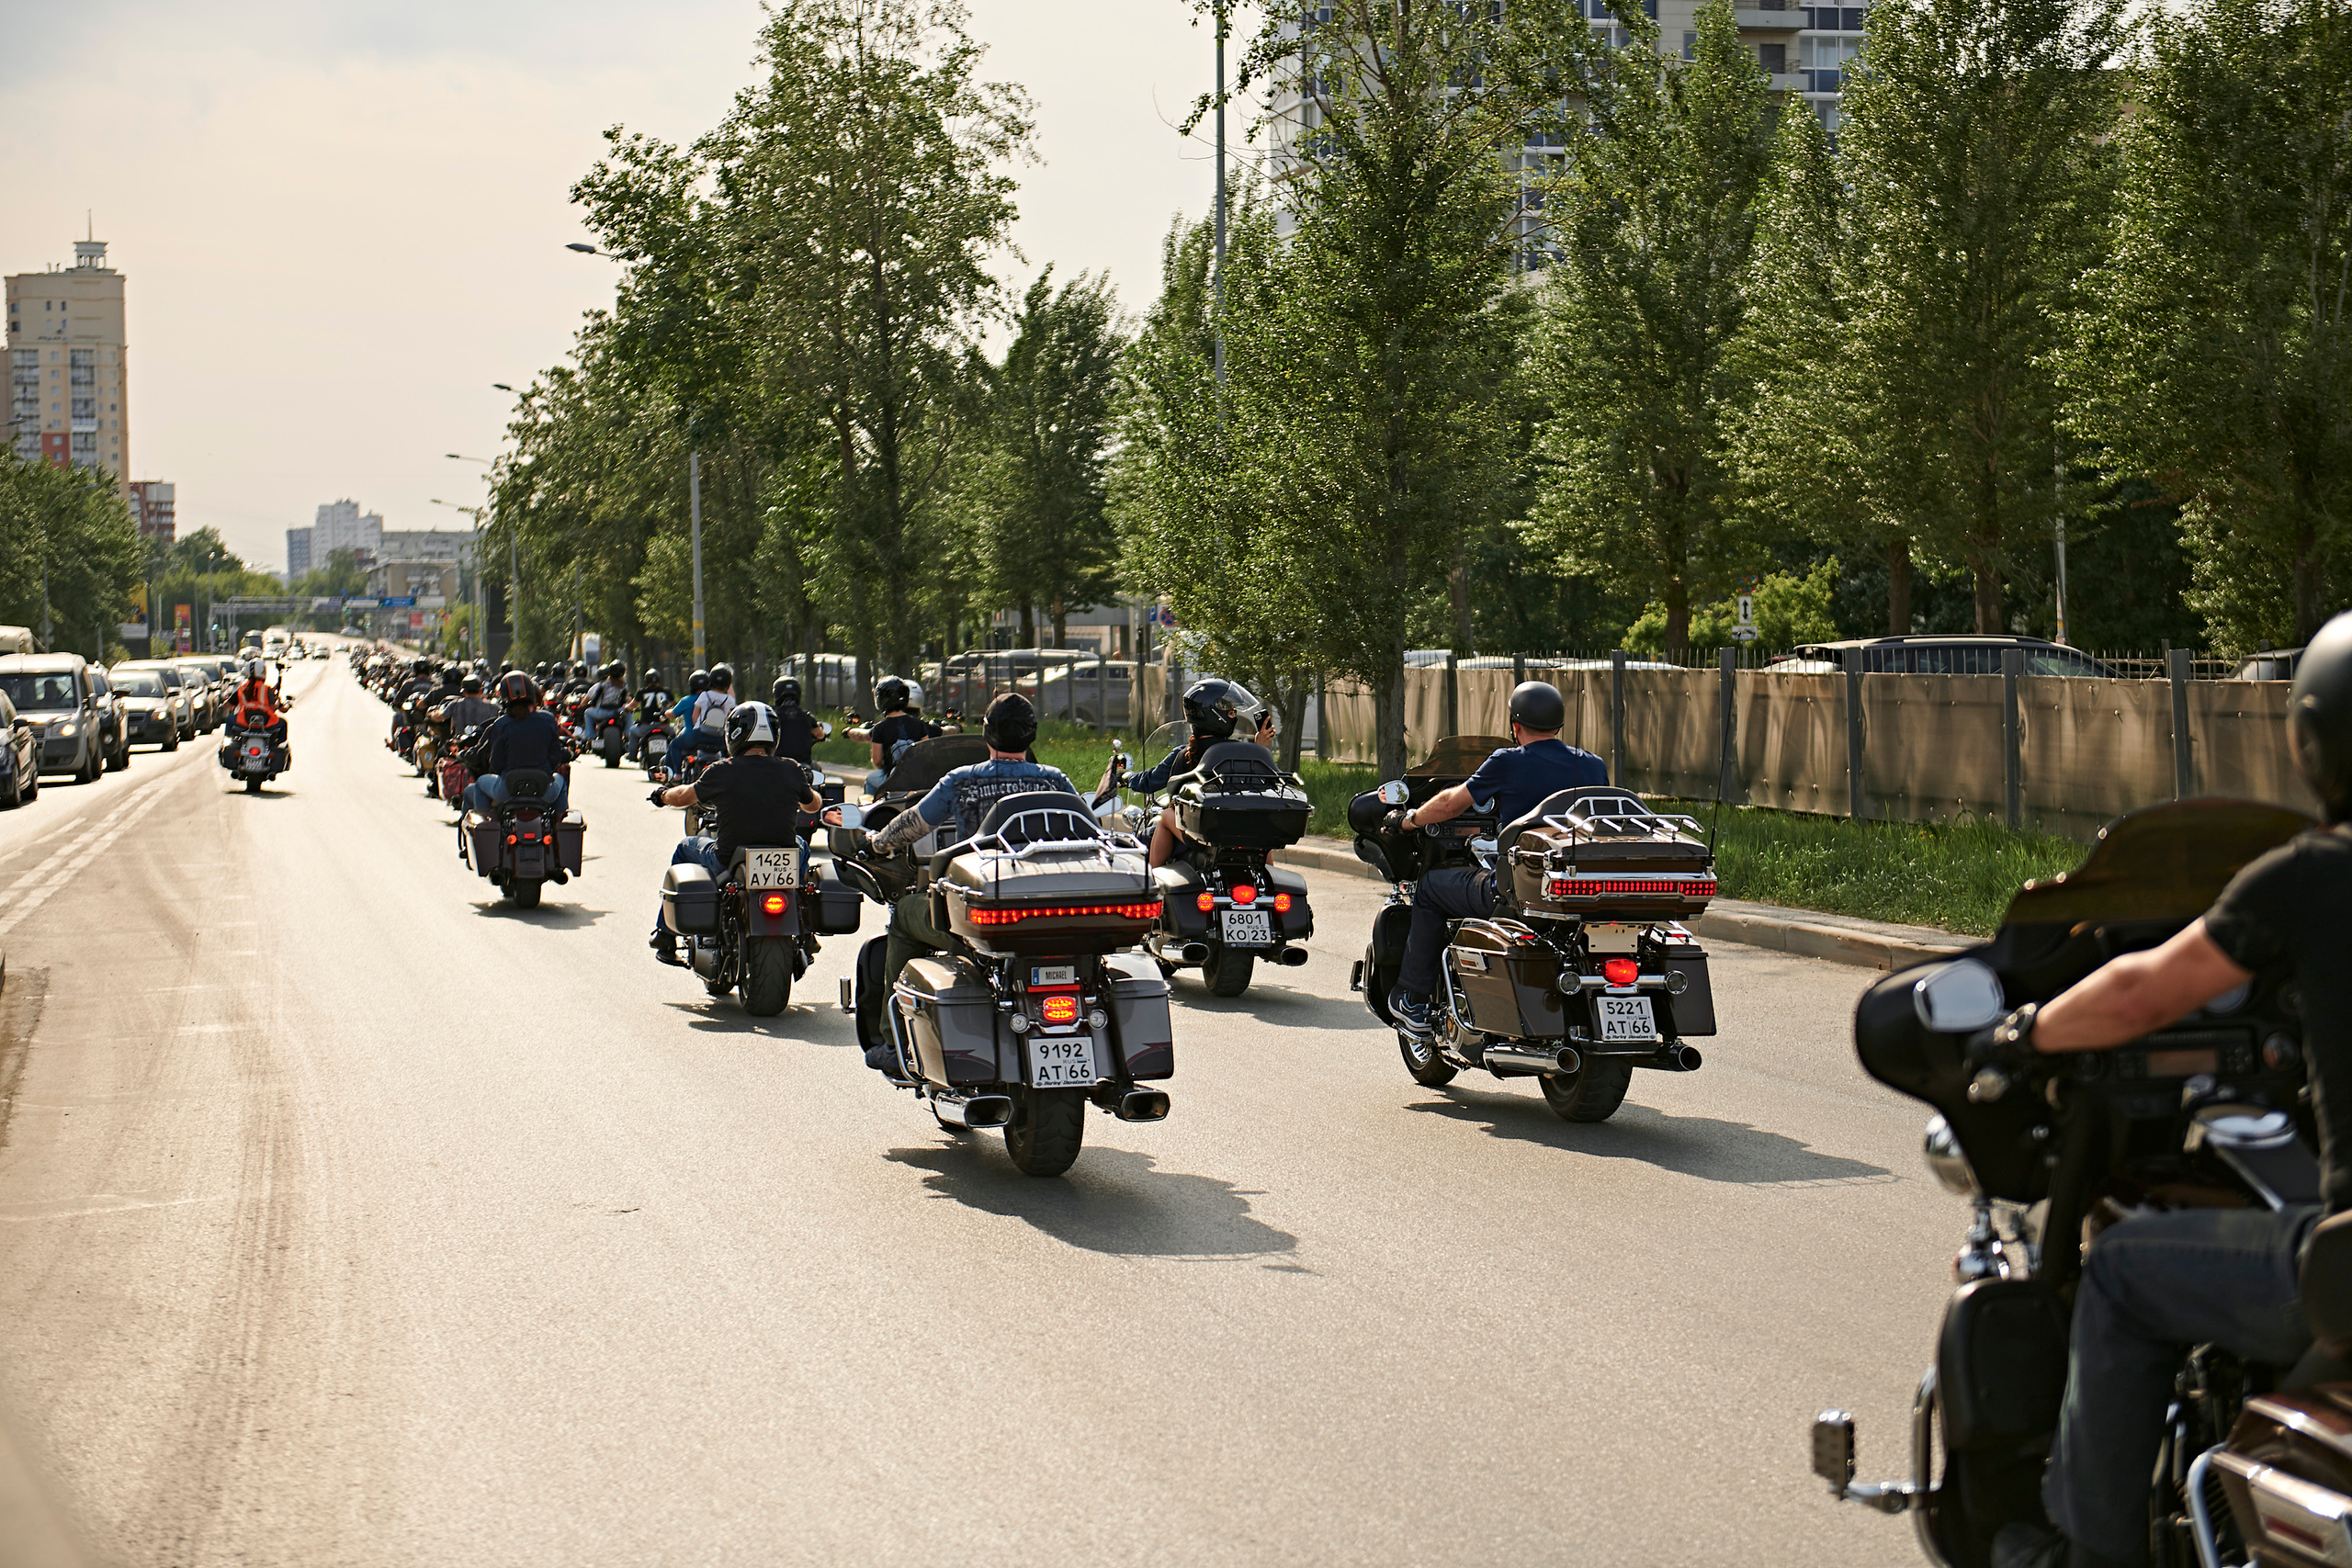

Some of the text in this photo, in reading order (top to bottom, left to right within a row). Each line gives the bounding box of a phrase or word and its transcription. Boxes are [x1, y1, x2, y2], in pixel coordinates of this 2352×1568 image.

[755, 853, 791, 867] 1425
[777, 872, 795, 886] 66
[1228, 913, 1262, 925] 6801
[1250, 930, 1268, 942] 23
[1045, 970, 1068, 980] MICHAEL
[1606, 1001, 1644, 1015] 5221
[1632, 1020, 1651, 1033] 66
[1039, 1043, 1083, 1059] 9192
[1069, 1064, 1091, 1078] 66
